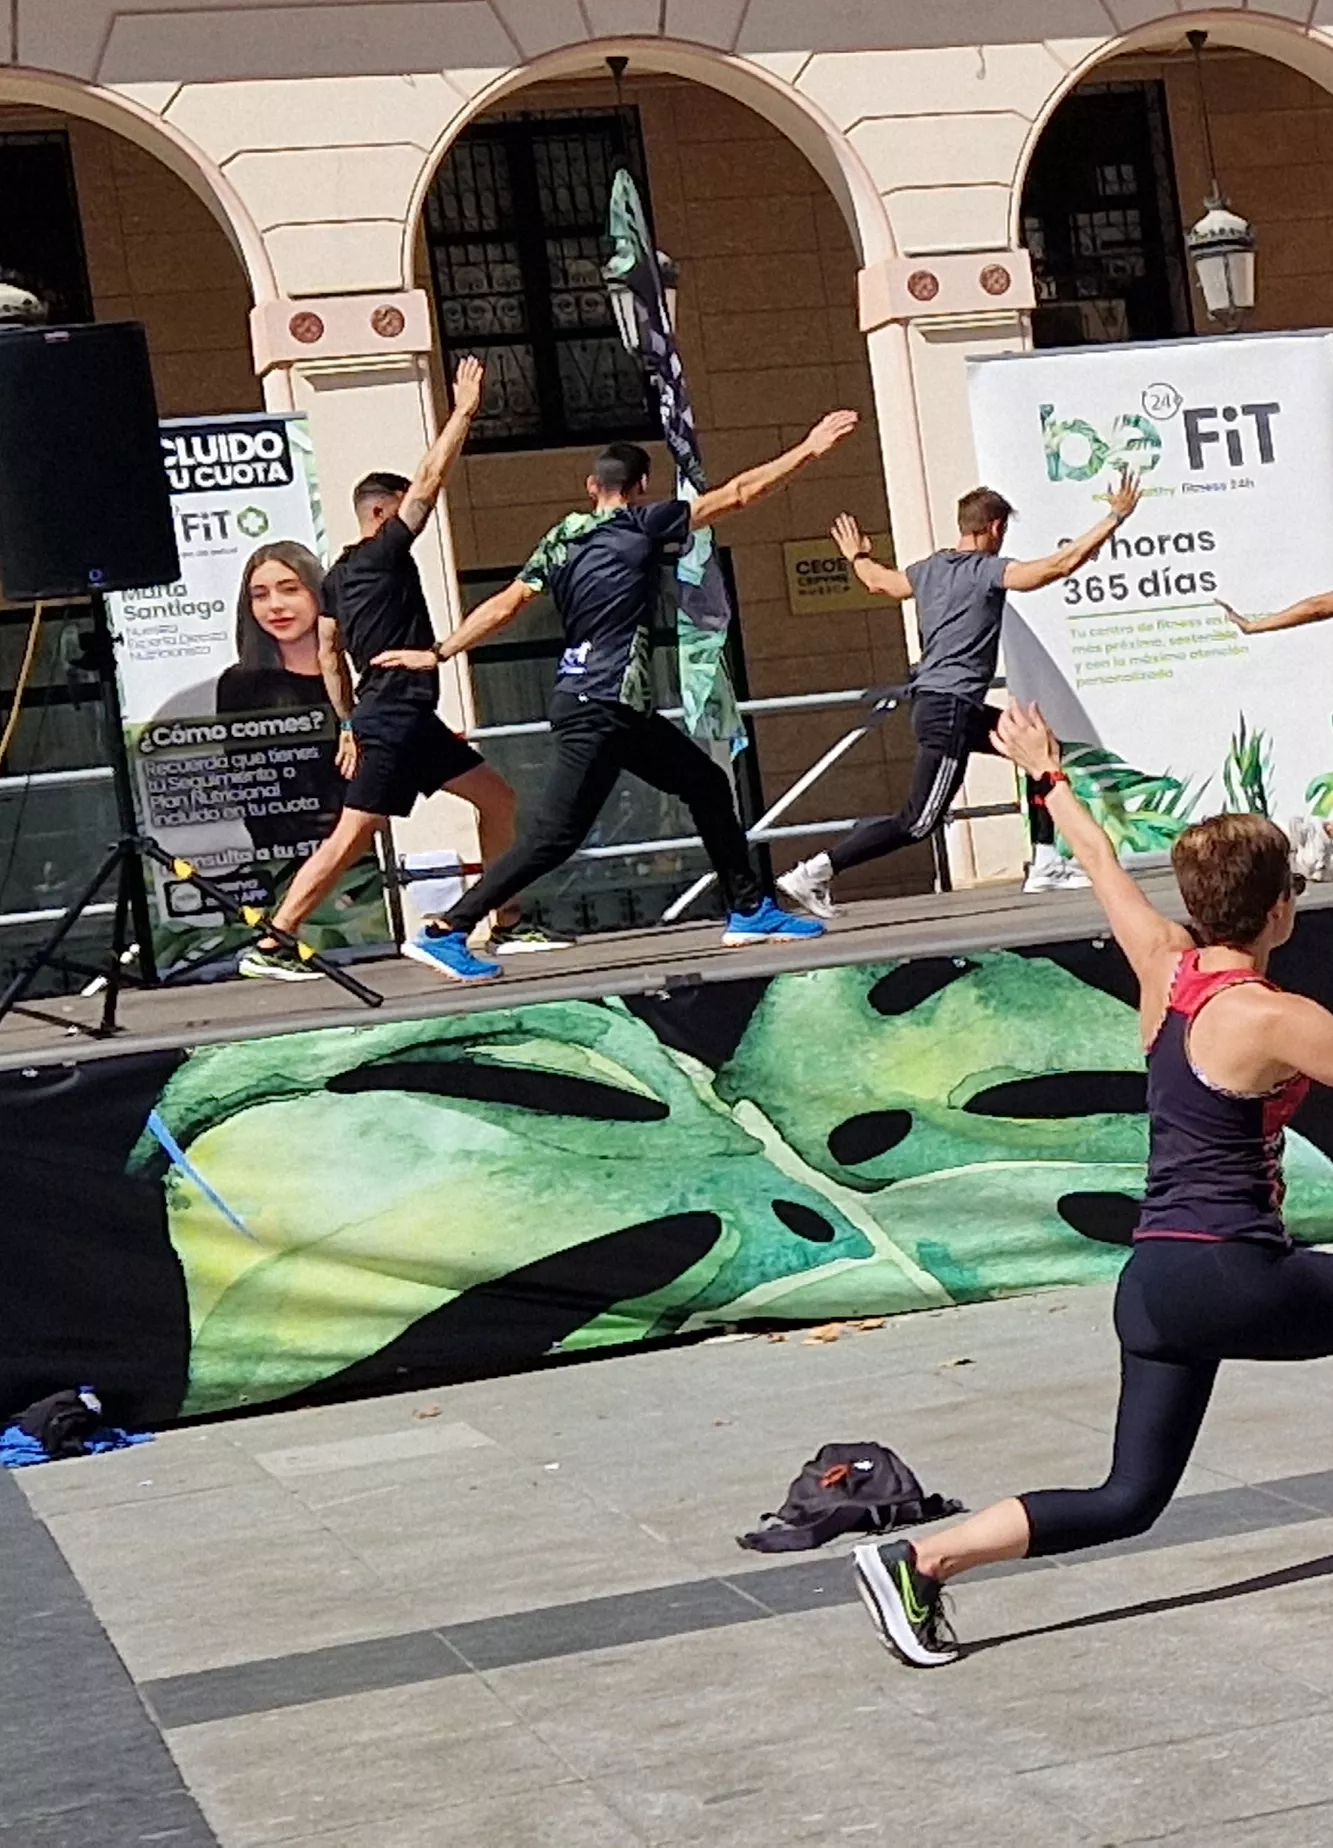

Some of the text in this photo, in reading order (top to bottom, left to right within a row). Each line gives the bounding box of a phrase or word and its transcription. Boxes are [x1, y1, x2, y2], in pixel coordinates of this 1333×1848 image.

[1038, 403, 1162, 482] be
[1182, 402, 1280, 470] FiT
[166, 461, 289, 490] U CUOTA
[181, 509, 230, 542] FiT
[1110, 529, 1216, 560] horas
[1063, 565, 1218, 605] 365 días
[123, 598, 225, 620] Santiago
[140, 710, 325, 753] ¿Cómo comes?
[145, 756, 230, 777] Recuerda
[231, 751, 267, 770] que
[222, 805, 246, 819] en
[248, 802, 268, 816] tu
[268, 796, 320, 813] cuota
[272, 843, 295, 859] tu
[296, 839, 321, 856] ST
